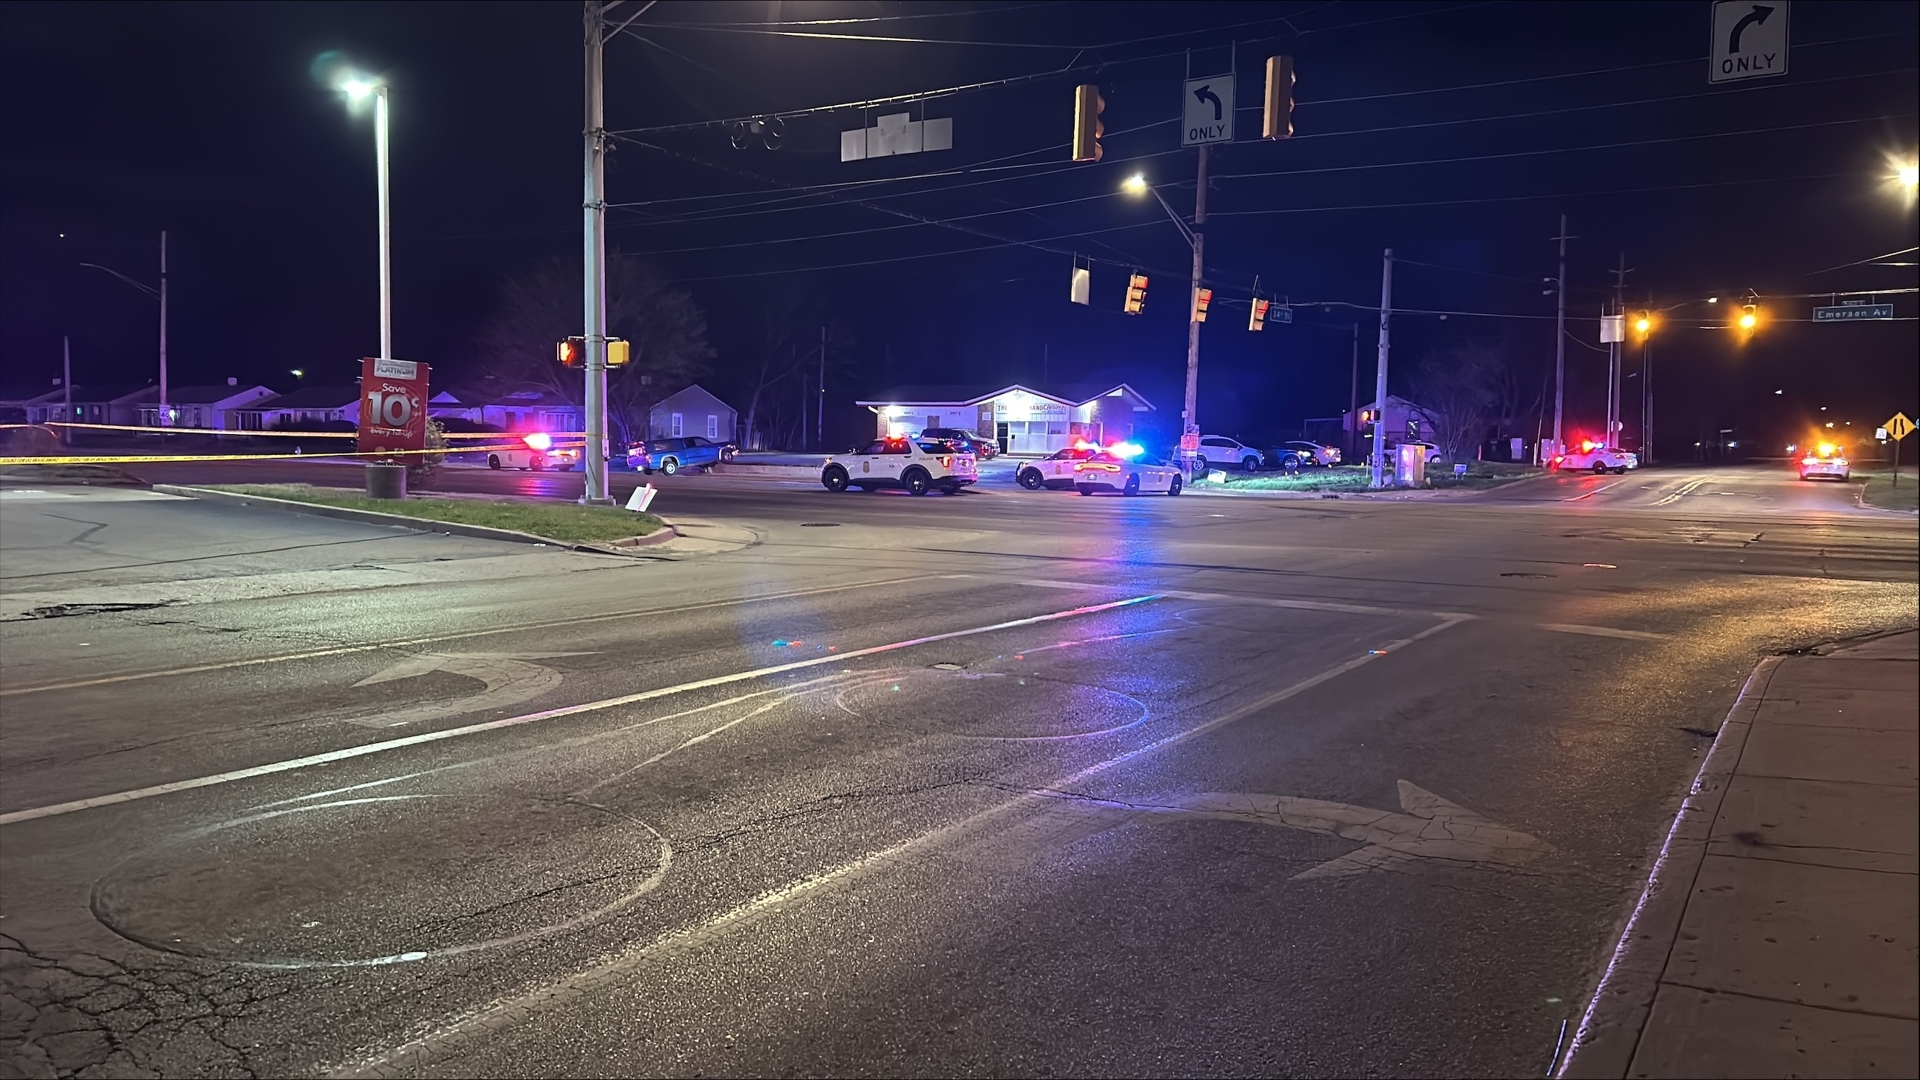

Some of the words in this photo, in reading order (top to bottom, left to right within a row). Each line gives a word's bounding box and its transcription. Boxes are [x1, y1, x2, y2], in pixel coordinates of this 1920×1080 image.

[1722, 53, 1776, 74] ONLY
[1189, 124, 1225, 140] ONLY
[1817, 310, 1867, 319] Emerson
[1873, 308, 1888, 316] Av
[376, 366, 415, 376] PLATINUM
[382, 383, 407, 394] Save
[370, 428, 390, 437] every
